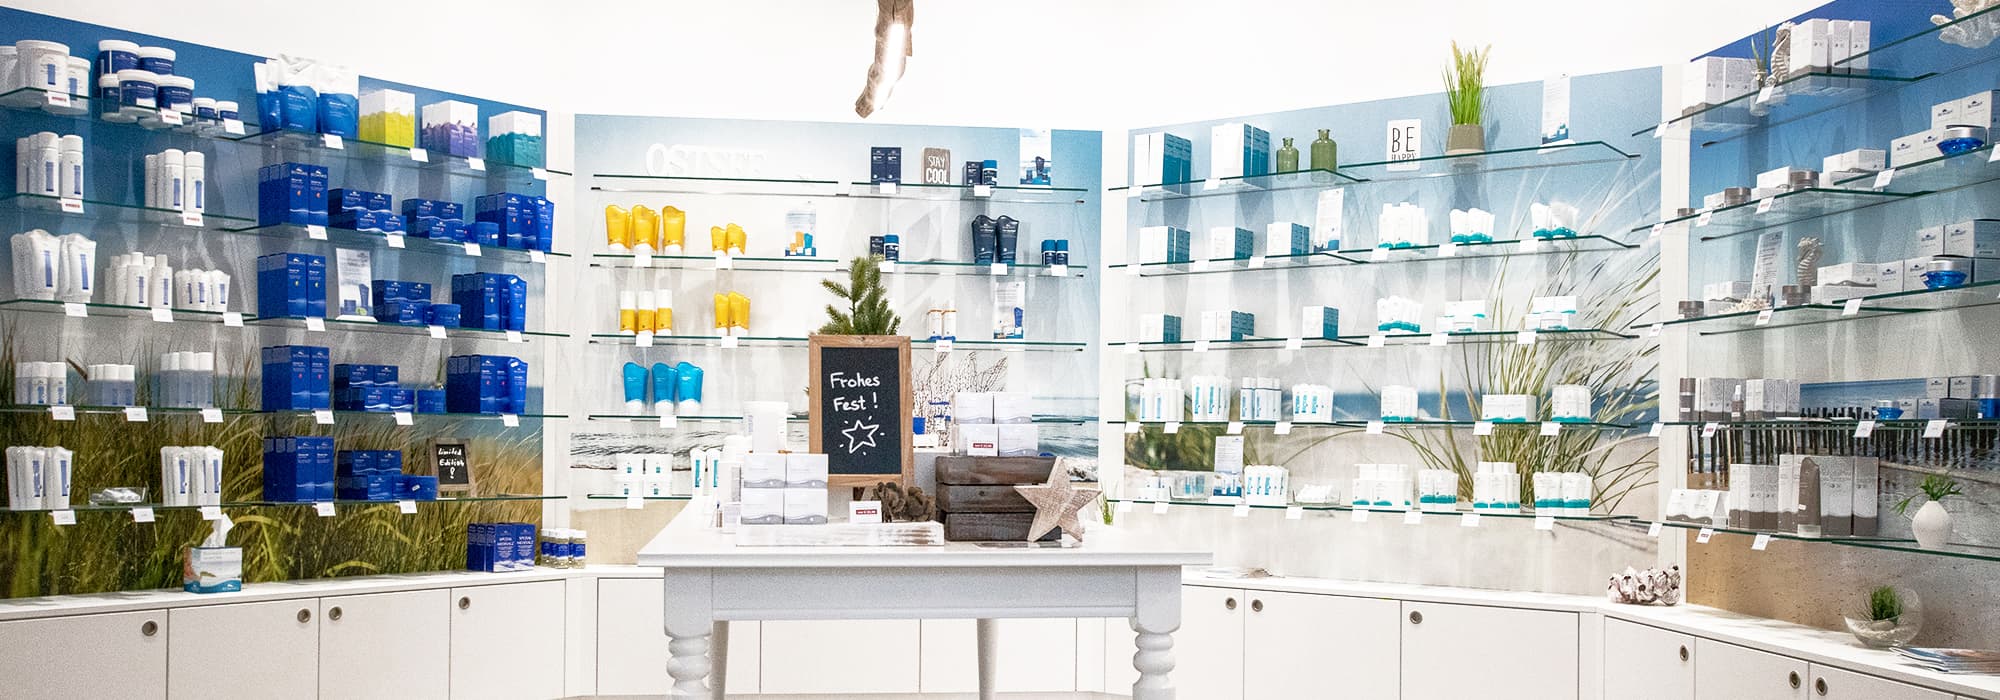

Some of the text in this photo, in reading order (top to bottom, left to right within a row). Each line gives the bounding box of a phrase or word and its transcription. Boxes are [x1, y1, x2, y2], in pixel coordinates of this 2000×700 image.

[1392, 127, 1416, 153] BE
[927, 155, 946, 168] STAY
[926, 168, 949, 184] COOL
[830, 372, 881, 389] Frohes
[833, 391, 879, 412] Fest !
[438, 447, 462, 456] Limited
